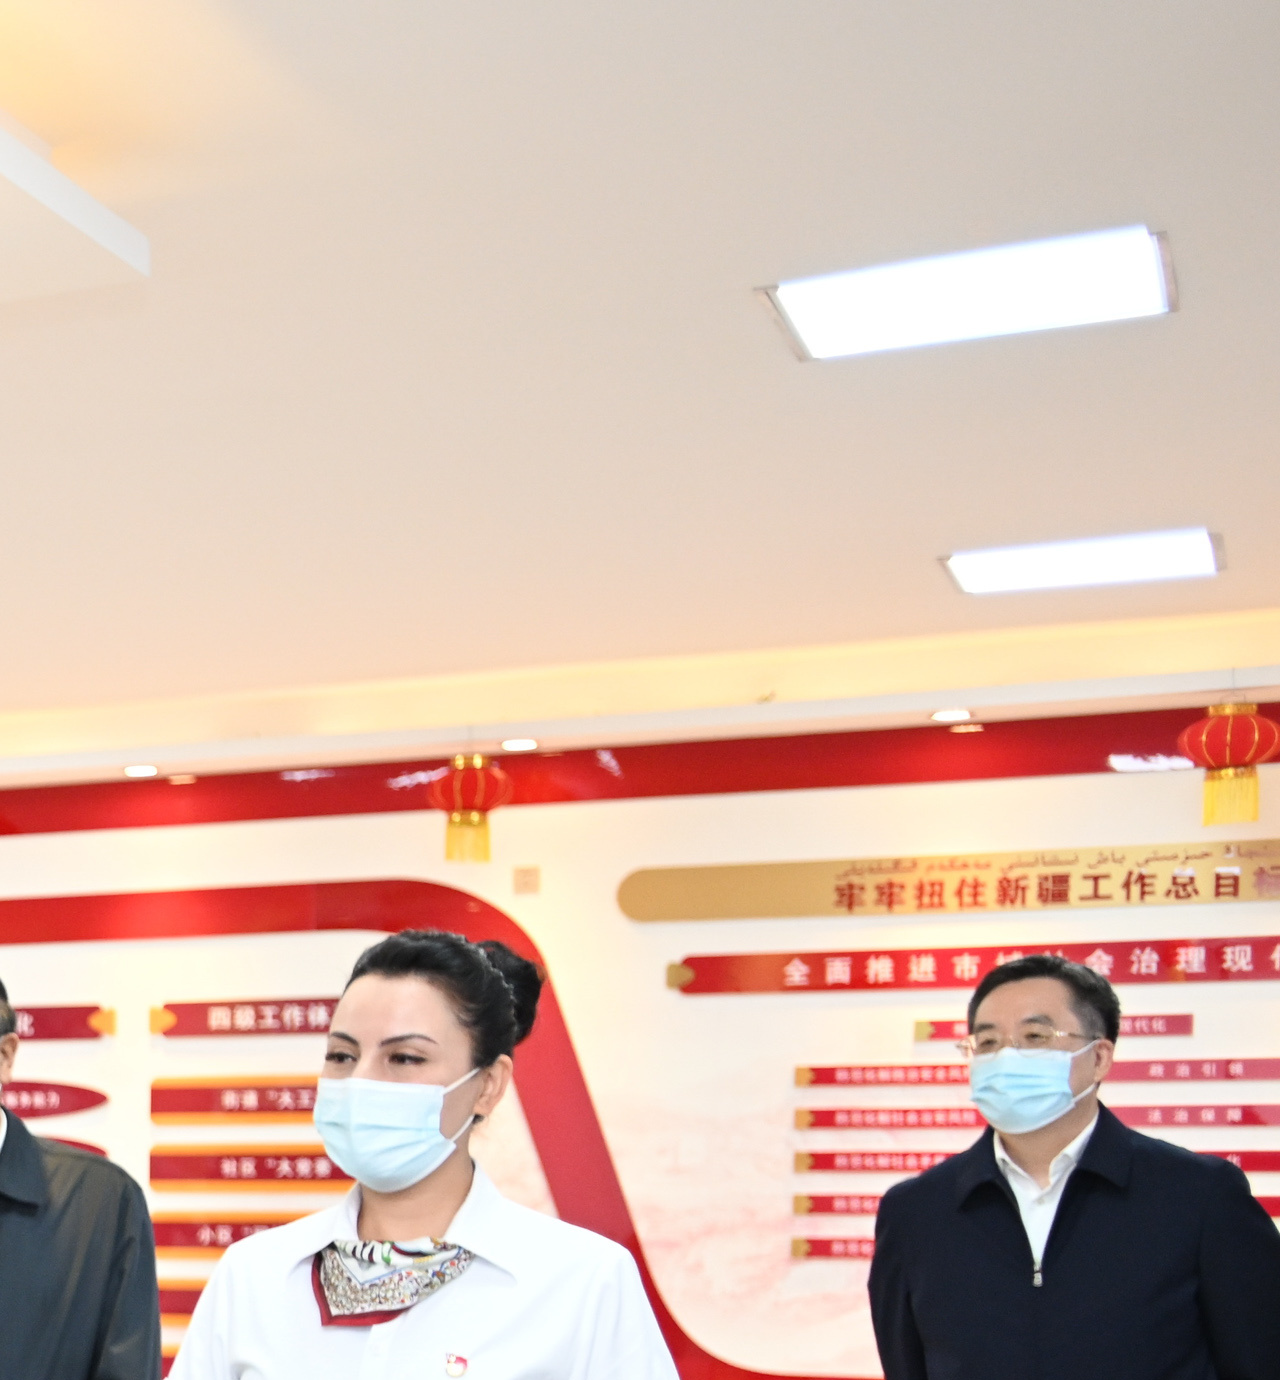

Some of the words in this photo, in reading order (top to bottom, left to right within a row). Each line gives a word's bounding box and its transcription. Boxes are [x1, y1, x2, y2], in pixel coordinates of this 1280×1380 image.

[783, 941, 1280, 987] 全面推进市会治理现
